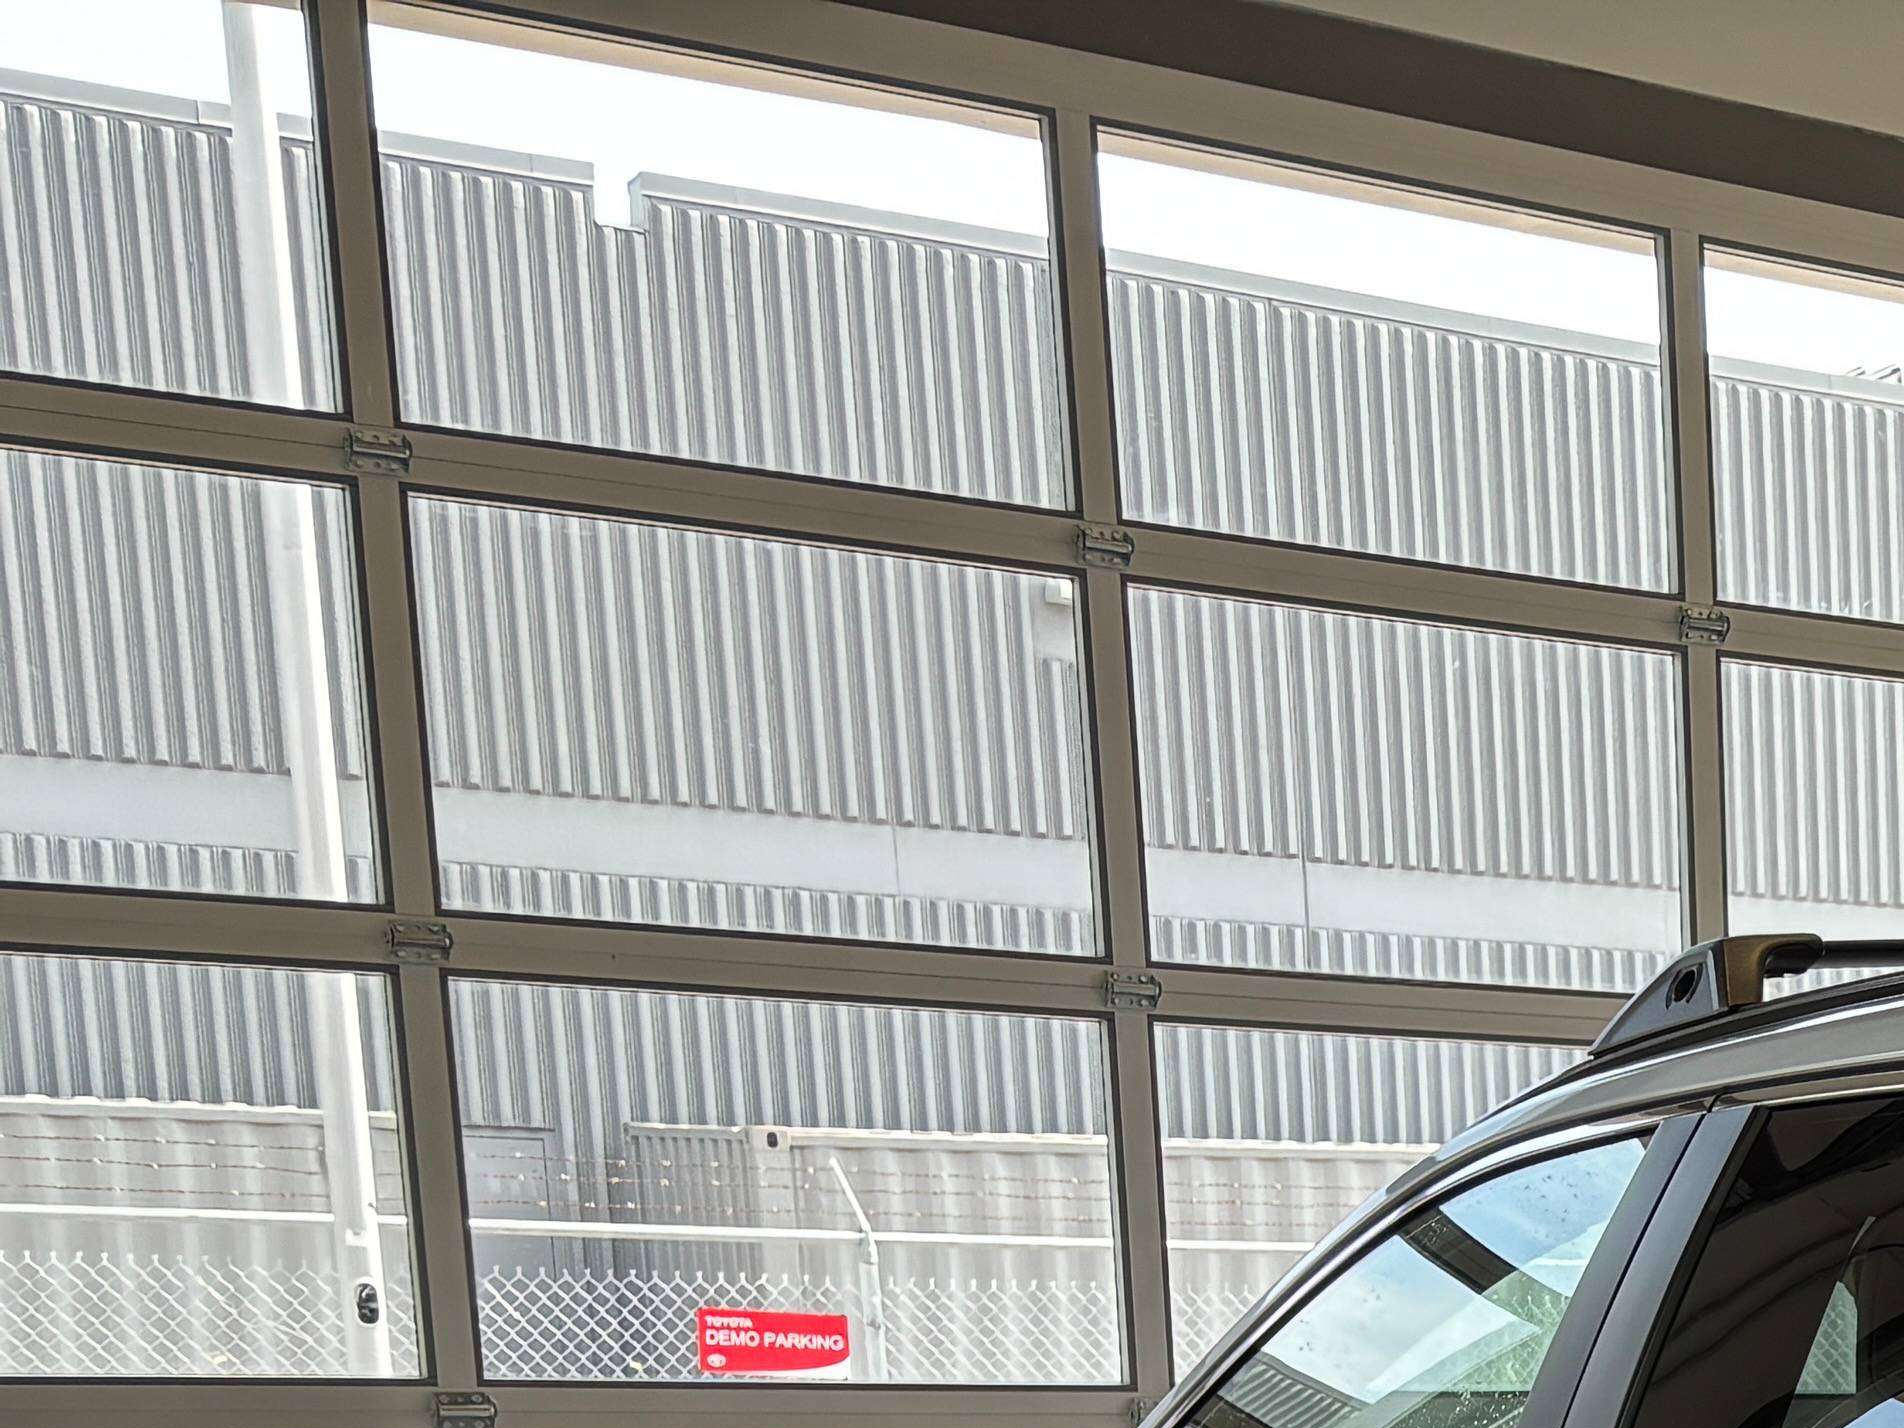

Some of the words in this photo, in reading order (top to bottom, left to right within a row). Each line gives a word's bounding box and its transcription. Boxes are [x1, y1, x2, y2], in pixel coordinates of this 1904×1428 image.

[705, 1315, 753, 1328] TOYOTA
[705, 1329, 760, 1347] DEMO
[763, 1331, 846, 1351] PARKING
